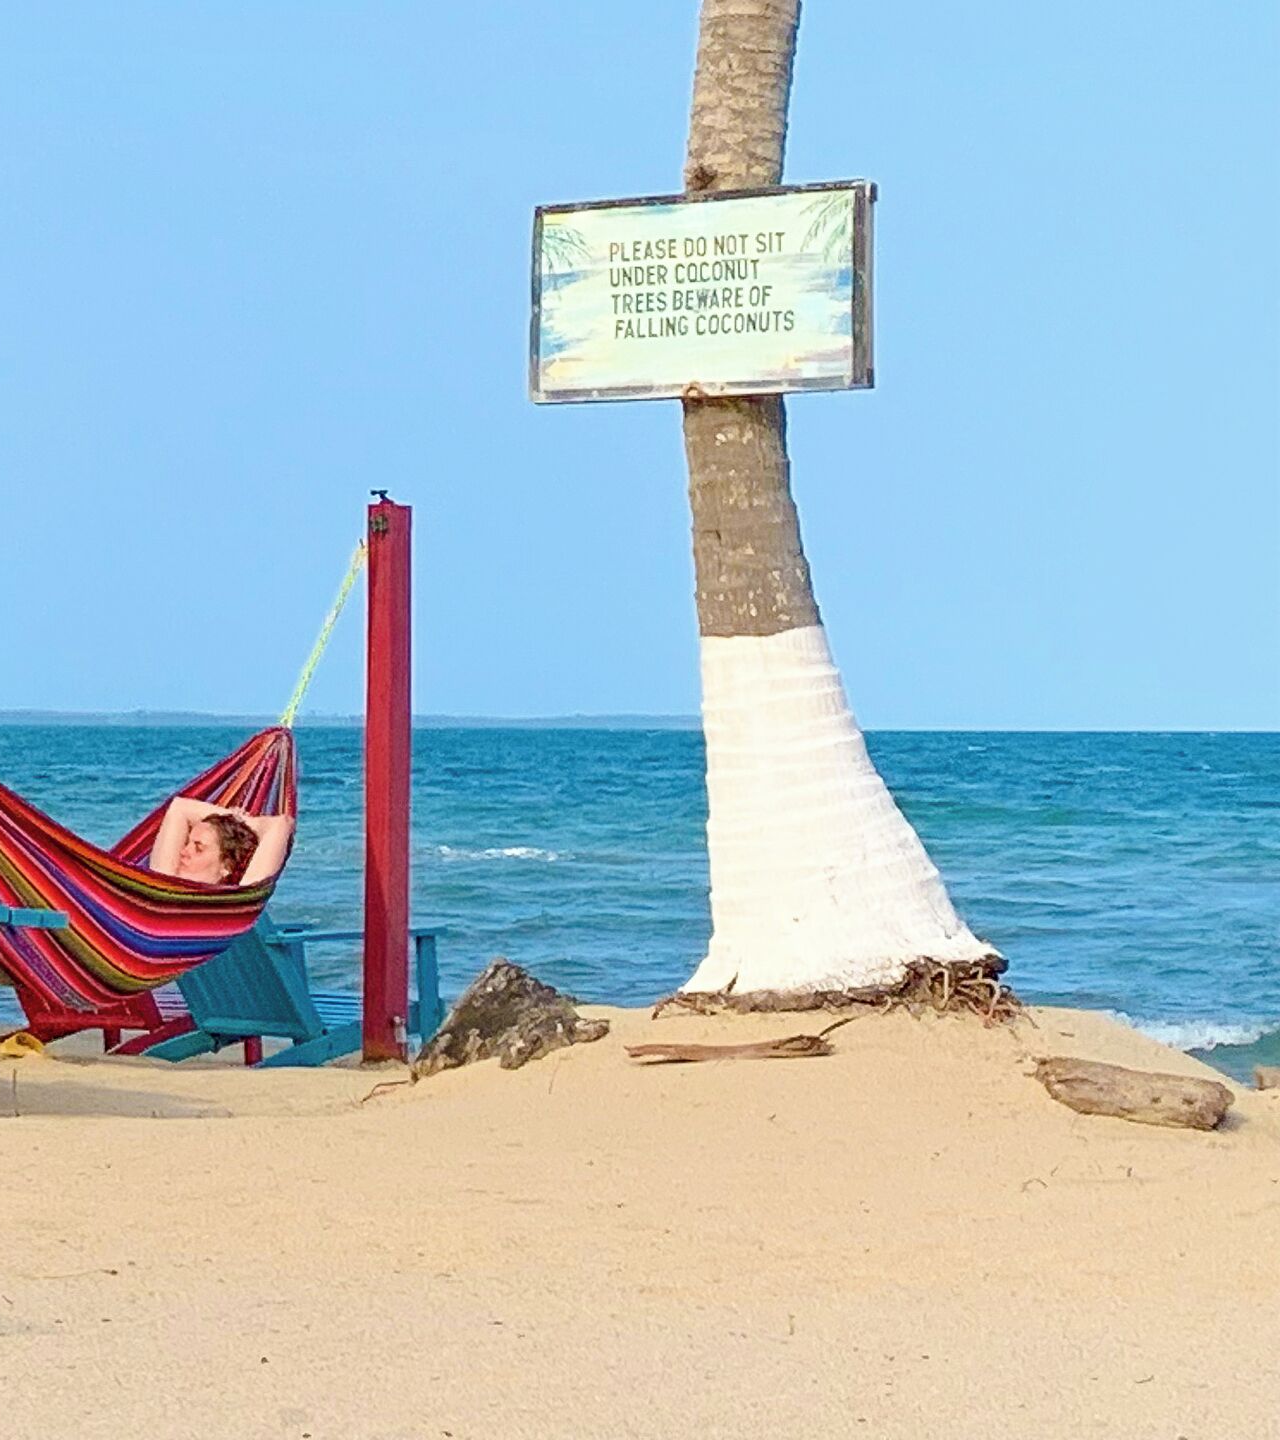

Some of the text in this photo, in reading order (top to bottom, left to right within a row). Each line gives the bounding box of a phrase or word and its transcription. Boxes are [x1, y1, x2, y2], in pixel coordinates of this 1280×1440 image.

[609, 231, 786, 263] PLEASE DO NOT SIT
[609, 259, 760, 288] UNDER COCONUT
[611, 285, 773, 315] TREES BEWARE OF
[614, 310, 795, 340] FALLING COCONUTS
